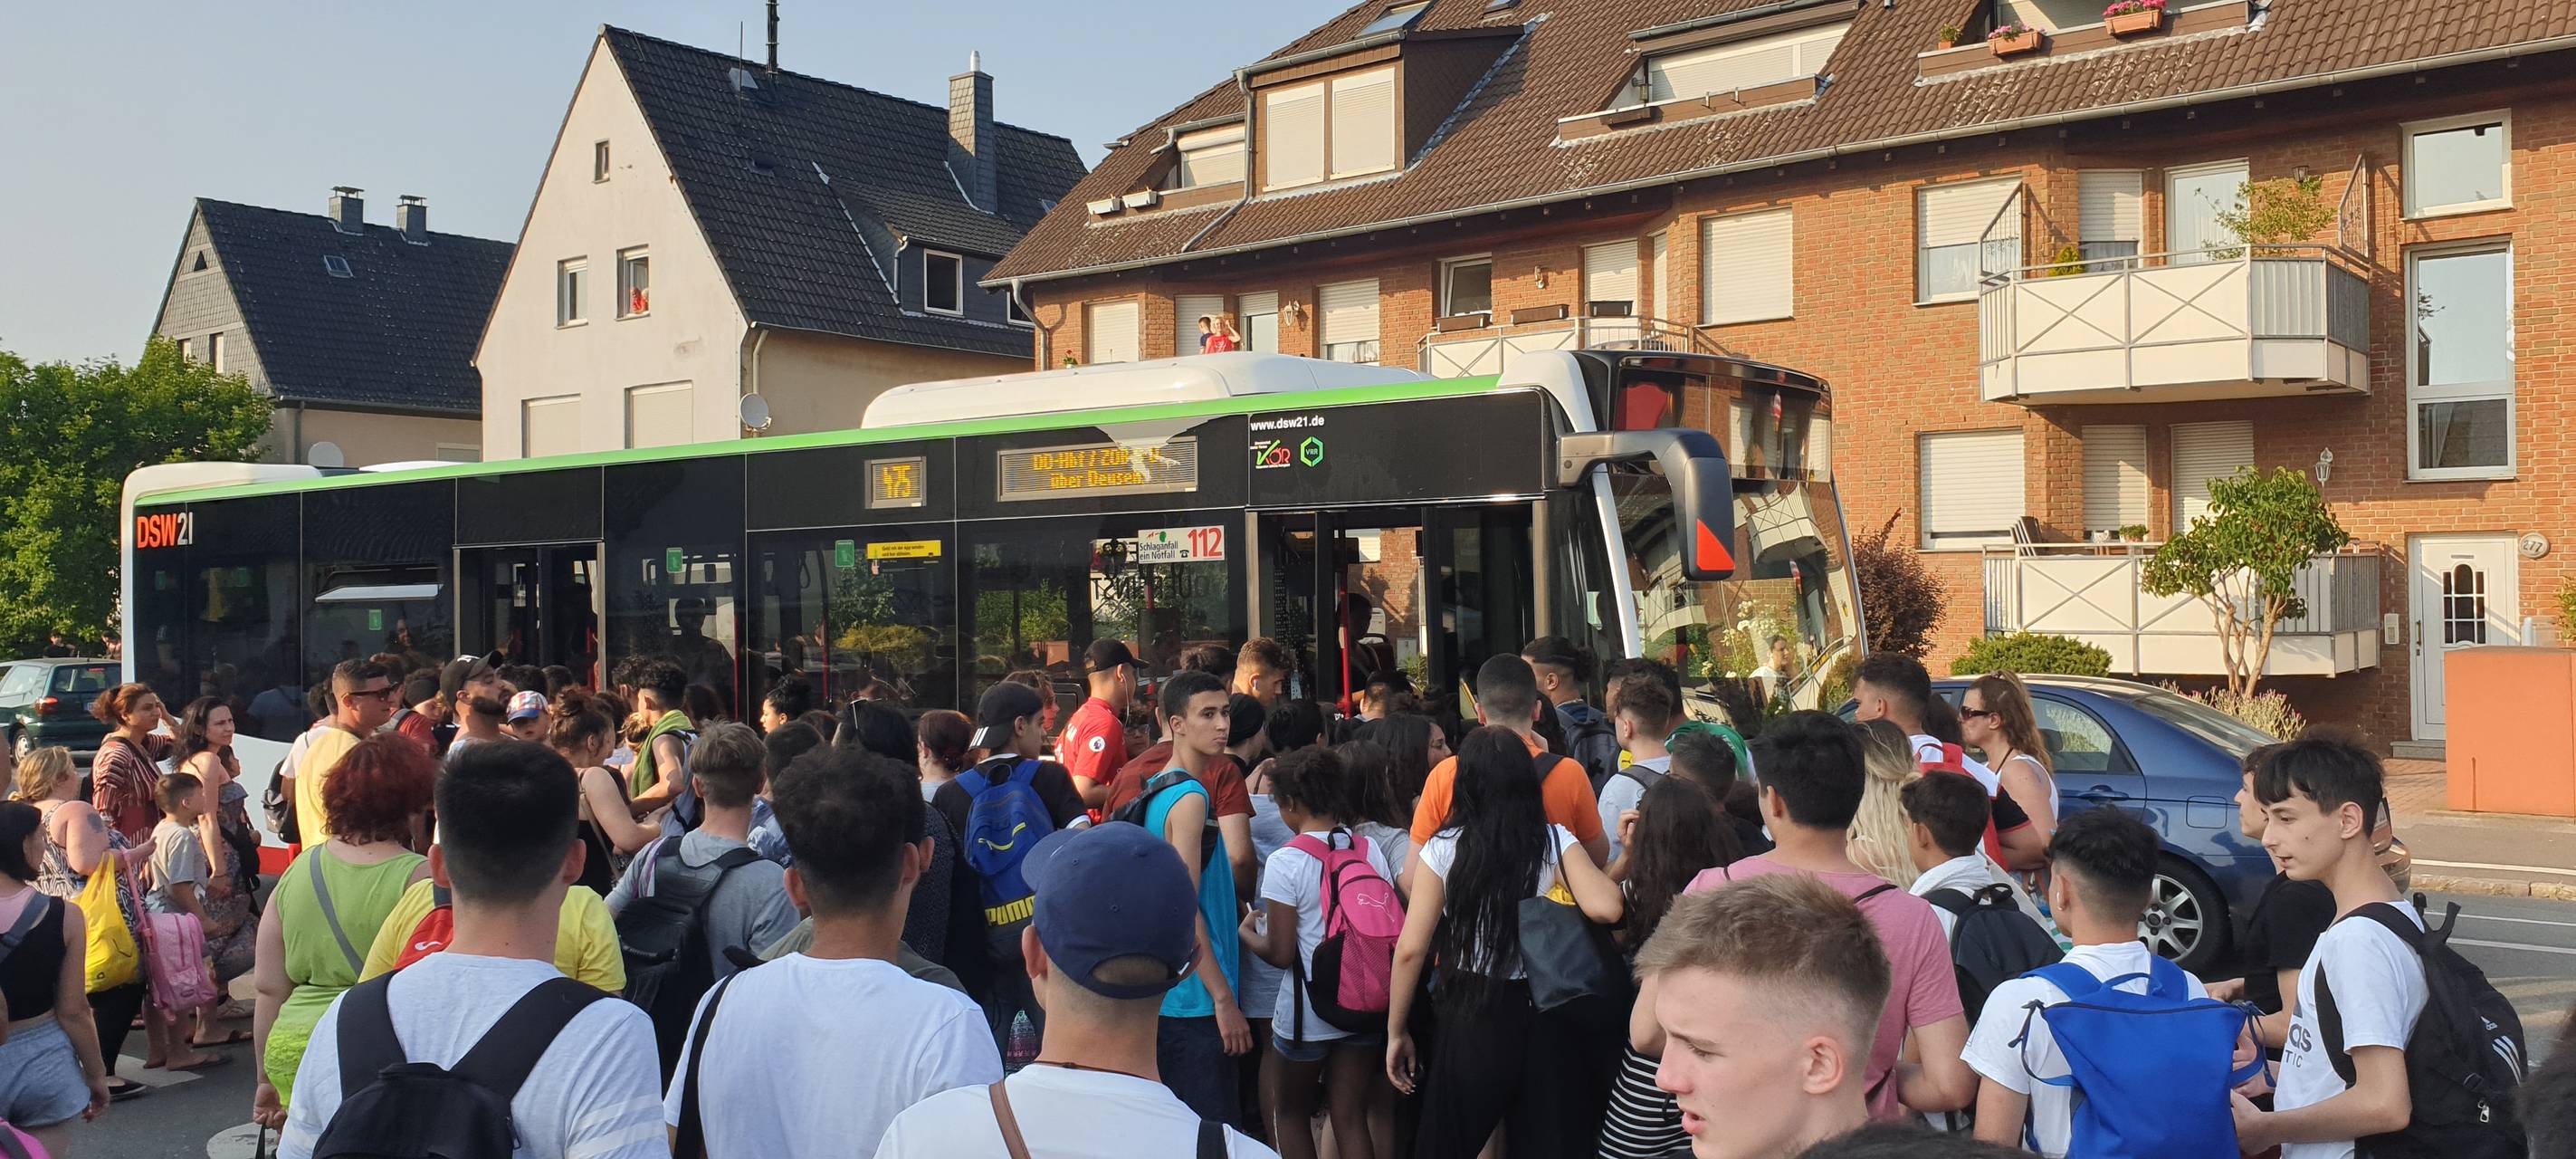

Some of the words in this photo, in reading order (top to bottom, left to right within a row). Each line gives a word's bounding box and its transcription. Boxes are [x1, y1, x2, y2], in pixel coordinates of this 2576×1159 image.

[1250, 416, 1325, 431] www.dsw21.de
[883, 465, 912, 498] 475
[137, 512, 193, 549] DSW21
[1140, 541, 1178, 551] Schlaganfall
[1188, 528, 1223, 557] 112
[2523, 540, 2543, 552] 277
[1151, 550, 1176, 560] Notfall
